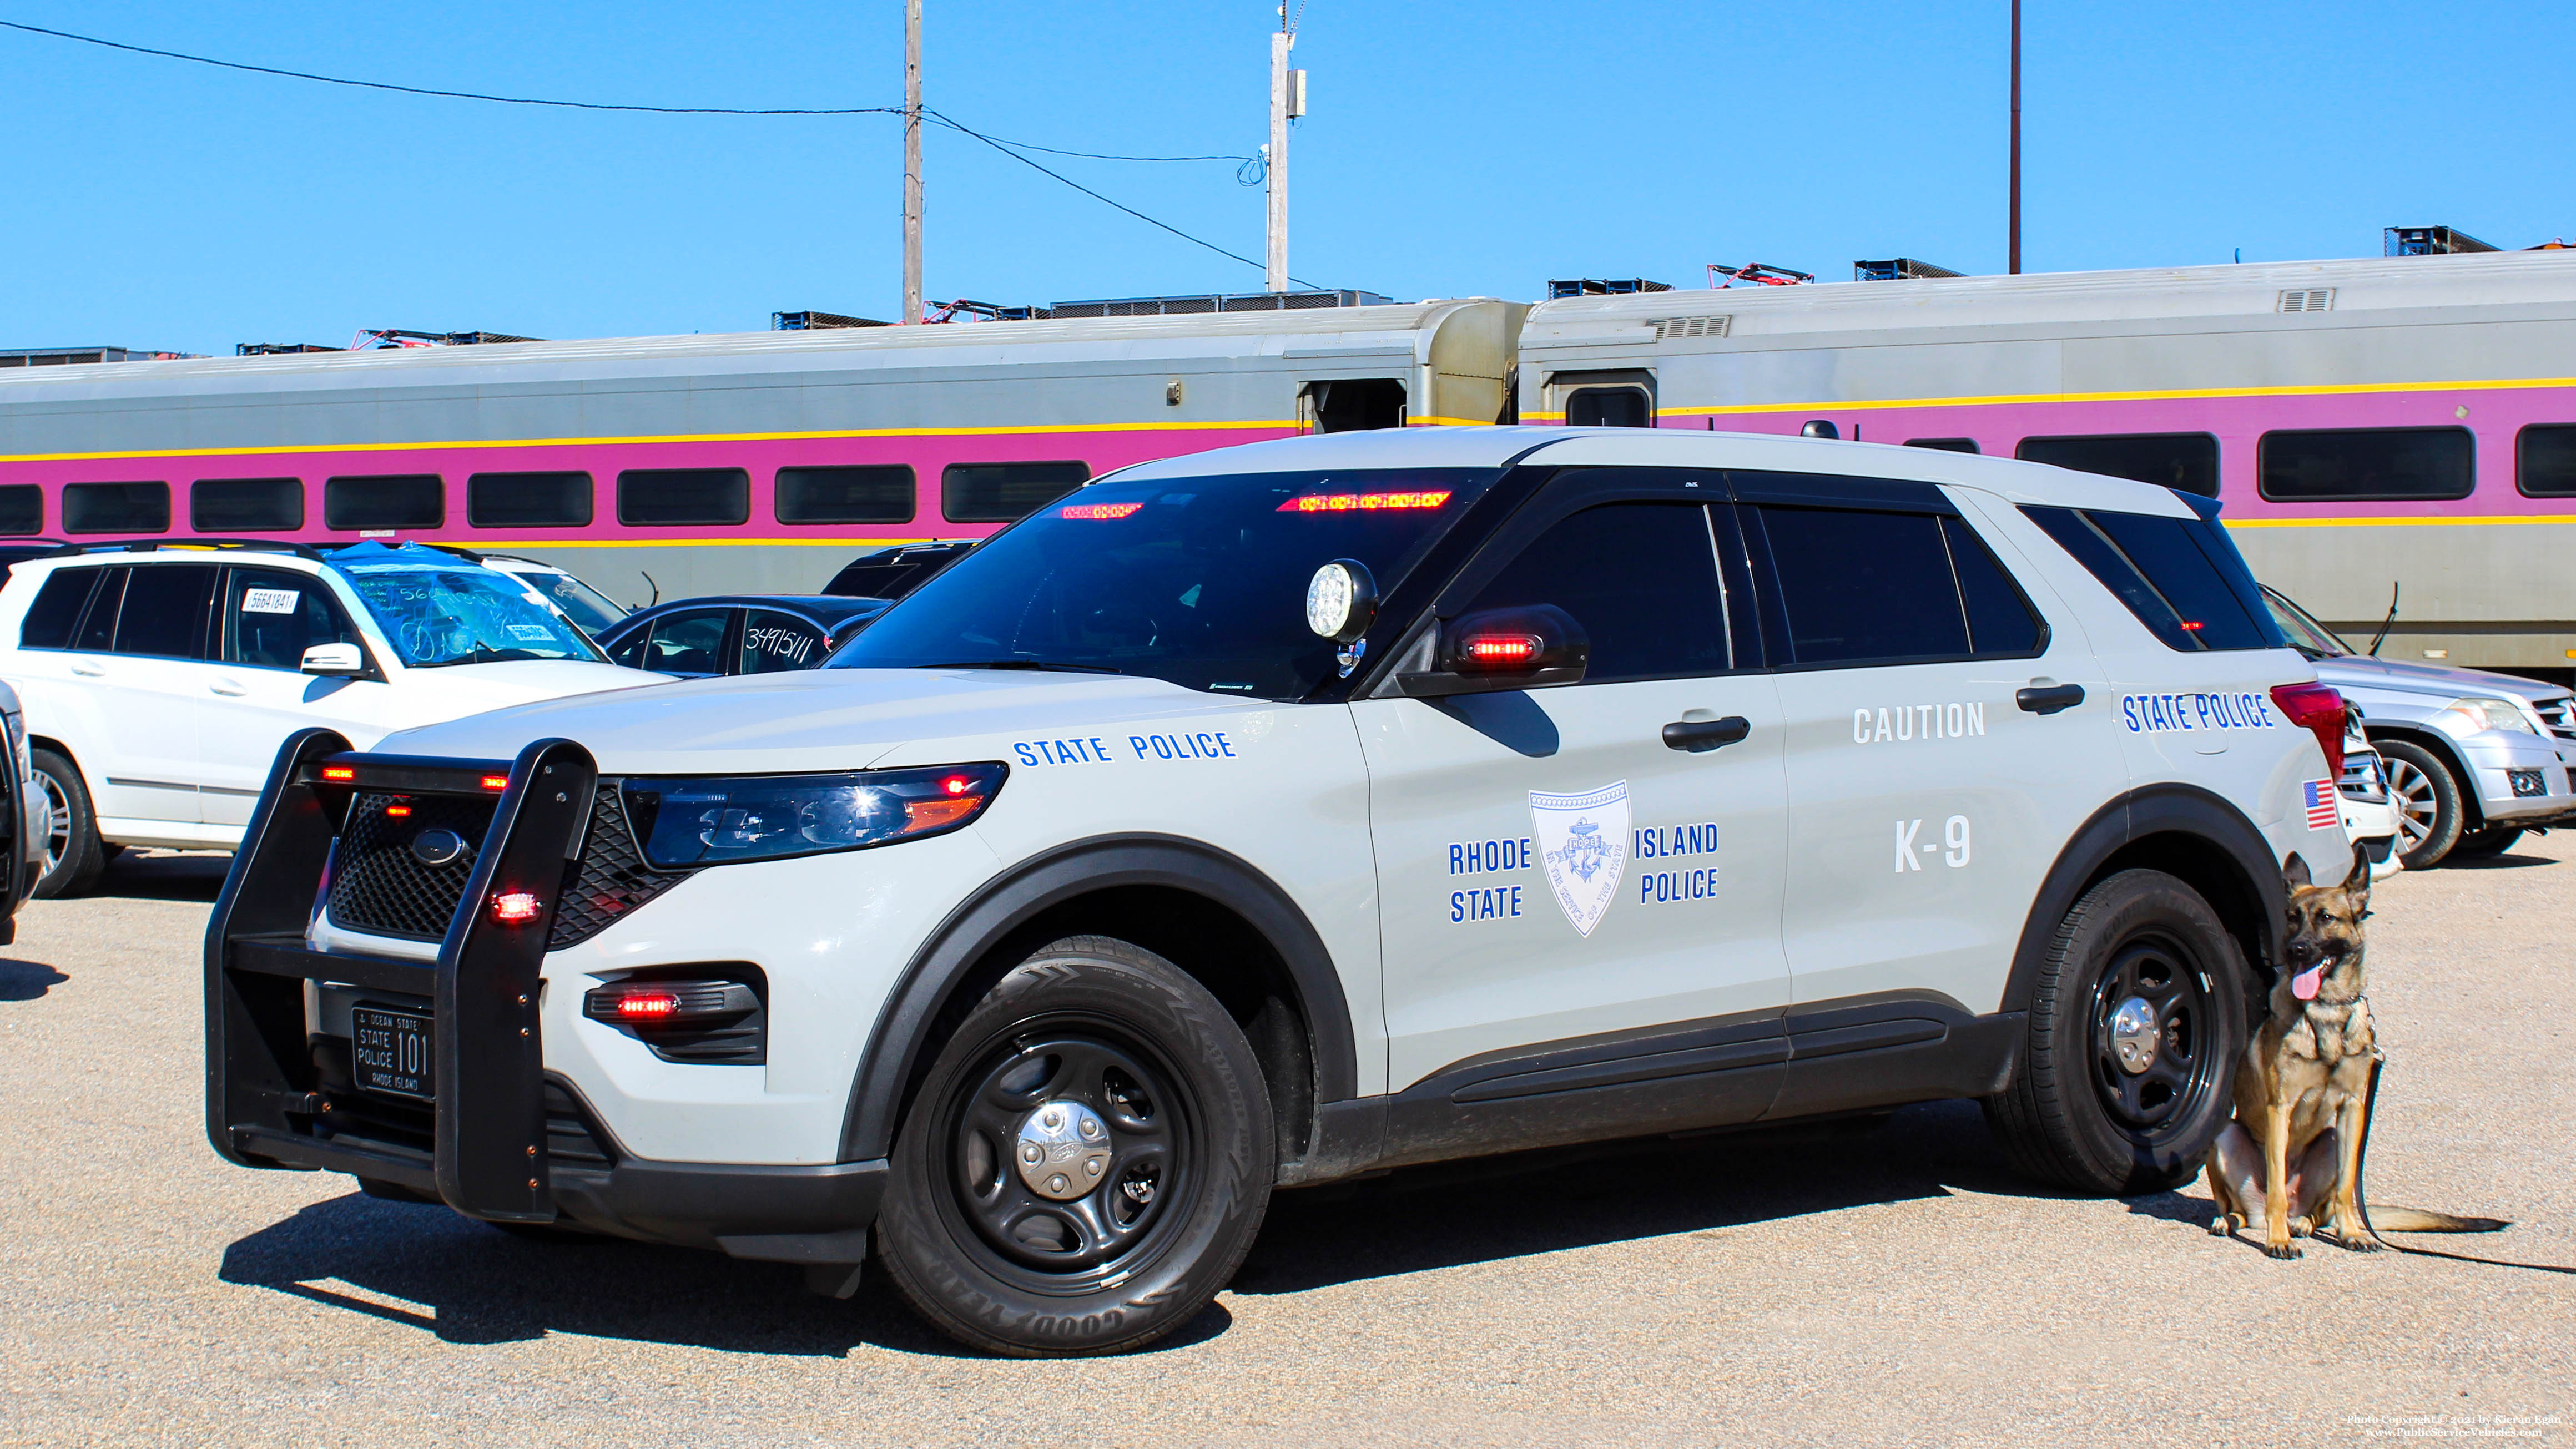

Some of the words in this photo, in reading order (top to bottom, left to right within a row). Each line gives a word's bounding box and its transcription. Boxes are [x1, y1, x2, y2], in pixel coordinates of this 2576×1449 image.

[1853, 702, 1985, 744] CAUTION
[2123, 694, 2193, 733] STATE
[2195, 693, 2275, 730] POLICE
[1014, 737, 1112, 767] STATE
[1128, 732, 1237, 760] POLICE
[1449, 837, 1531, 875] RHODE
[1635, 824, 1718, 859] ISLAND
[1572, 837, 1596, 847] HOPE
[1895, 815, 1970, 872] K-9
[1450, 886, 1523, 923] STATE
[1641, 868, 1718, 905] POLICE
[1546, 850, 1556, 864] IN
[1551, 864, 1564, 887] THE
[1560, 886, 1585, 923] SERVICE
[1587, 905, 1598, 921] OF
[1597, 881, 1611, 903] THE
[1609, 843, 1624, 879] STATE
[360, 1028, 390, 1048] STATE
[370, 1014, 393, 1028] OCEAN
[397, 1018, 418, 1031] STATE
[358, 1048, 394, 1068] POLICE
[398, 1031, 427, 1076] 101
[372, 1072, 393, 1088] RHODE
[395, 1077, 418, 1092] ISLAND
